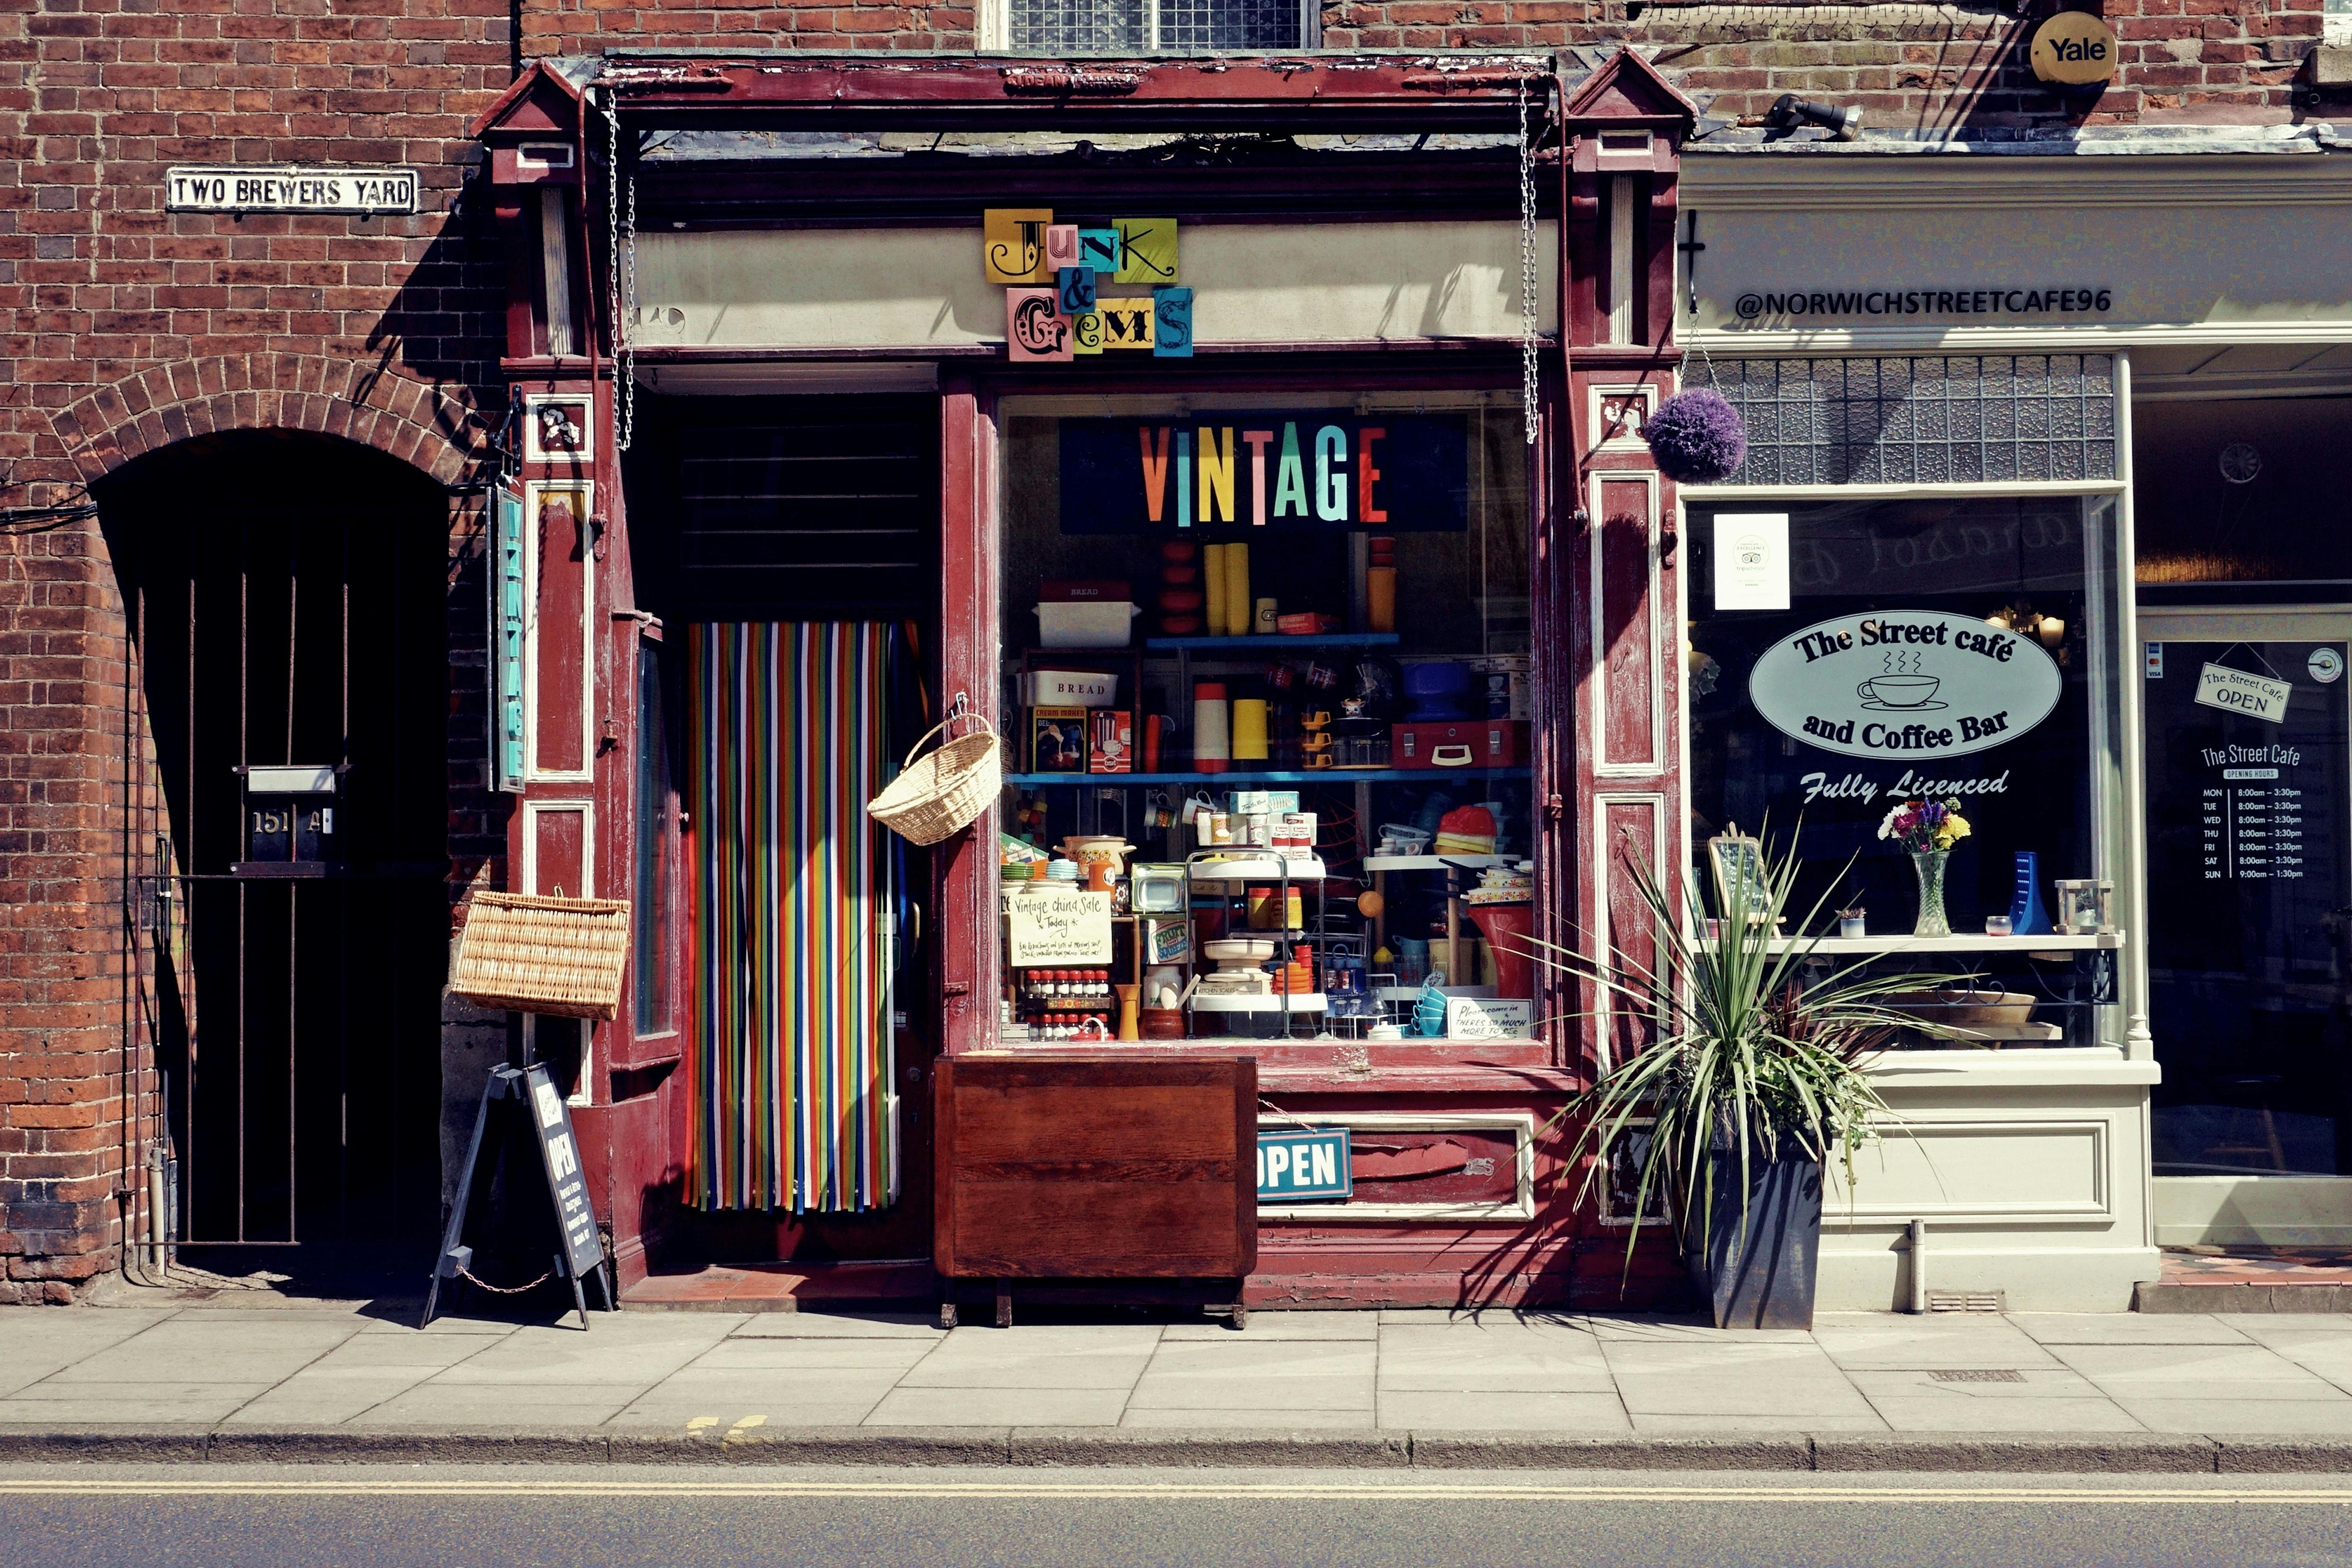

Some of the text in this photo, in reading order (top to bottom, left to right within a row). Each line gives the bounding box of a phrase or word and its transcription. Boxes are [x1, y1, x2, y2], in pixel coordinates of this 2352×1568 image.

[2049, 37, 2107, 62] Yale
[174, 178, 410, 205] TWO BREWERS YARD
[1063, 268, 1094, 311] &
[1735, 289, 2112, 319] @NORWICHSTREETCAFE96
[1138, 421, 1388, 528] VINTAGE
[506, 500, 523, 779] VINTAGE
[1793, 619, 2017, 663] The Street café
[1057, 683, 1105, 695] BREAD
[2204, 674, 2226, 684] The
[2229, 674, 2260, 690] Street
[2217, 688, 2268, 713] OPEN
[1802, 710, 2010, 749] and Coffee Bar
[2201, 744, 2300, 767] The Street Cafe
[1799, 769, 2010, 805] Fully Licenced
[2203, 789, 2222, 797] MON
[2238, 789, 2265, 797] 8:00am
[2274, 788, 2301, 798] 3:30pm
[2274, 802, 2302, 812] 3:30pm
[252, 811, 322, 834] 151 A
[2274, 816, 2302, 825] 3:30pm
[2275, 829, 2302, 839] 3:30pm
[2275, 843, 2302, 852] 3:30pm
[2275, 856, 2303, 866] 3:30pm
[2276, 870, 2303, 880] 1:30pm
[1015, 898, 1049, 924] Vintage
[1079, 896, 1102, 915] Sale
[1043, 915, 1068, 938] Today
[1153, 924, 1187, 947] FRUIT
[1458, 1005, 1485, 1018] Please
[548, 1131, 577, 1182] OPEN
